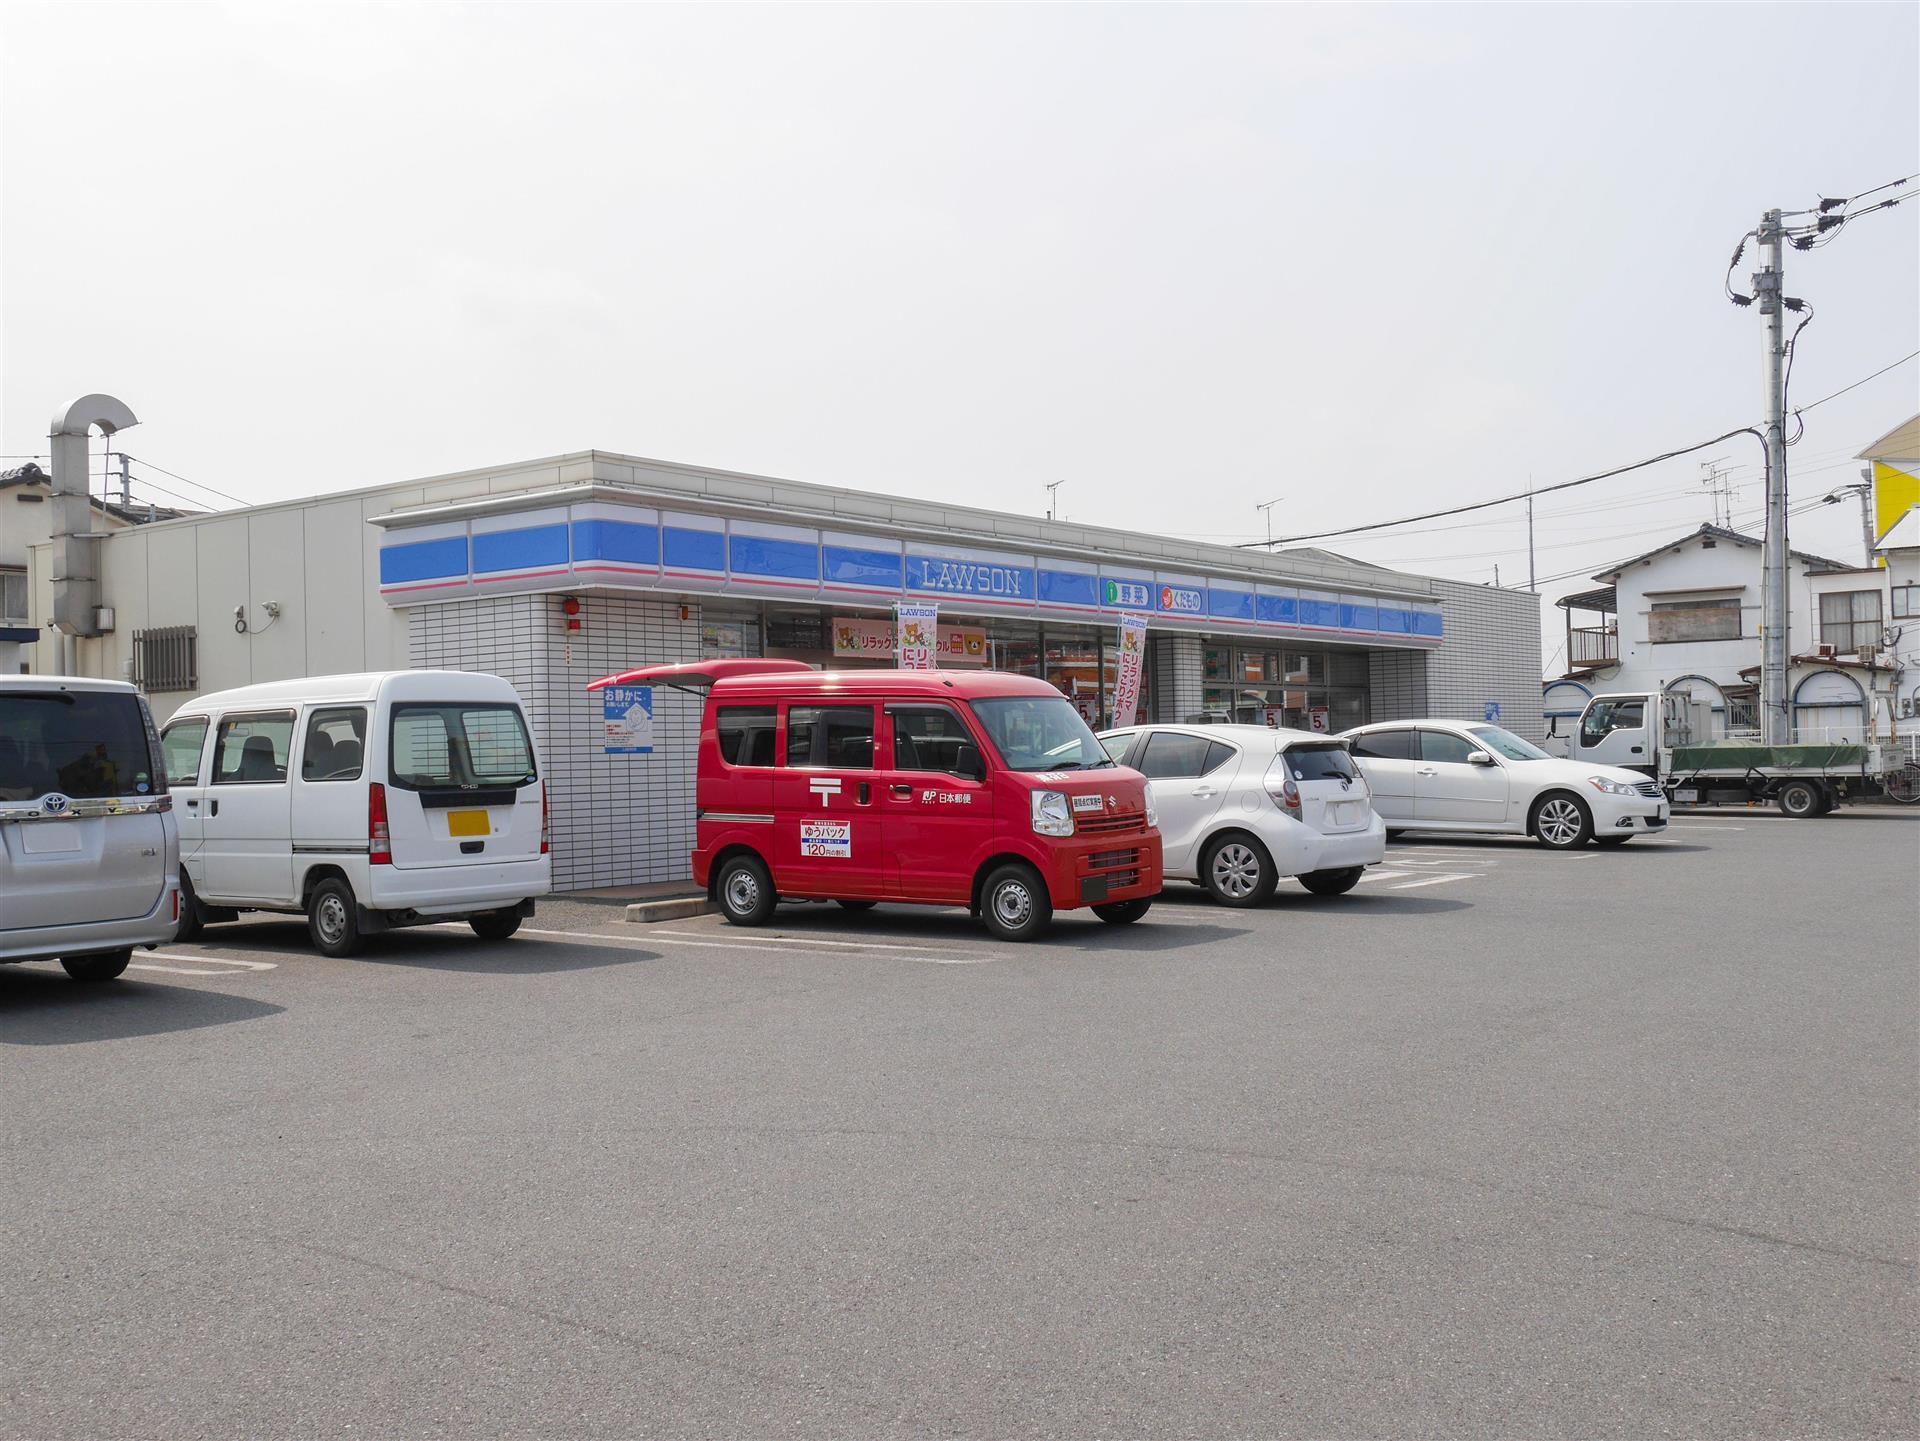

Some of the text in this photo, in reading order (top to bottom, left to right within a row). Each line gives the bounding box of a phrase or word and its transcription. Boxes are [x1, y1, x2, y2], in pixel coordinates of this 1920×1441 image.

[922, 561, 1020, 594] LAWSON
[1121, 585, 1144, 604] 野菜
[1174, 591, 1200, 609] くだもの
[900, 608, 936, 617] LAWSON
[1123, 617, 1146, 629] LAWSON
[1124, 654, 1139, 711] リラックマ
[939, 793, 971, 804] 日本郵便
[804, 826, 846, 838] ゆうパック
